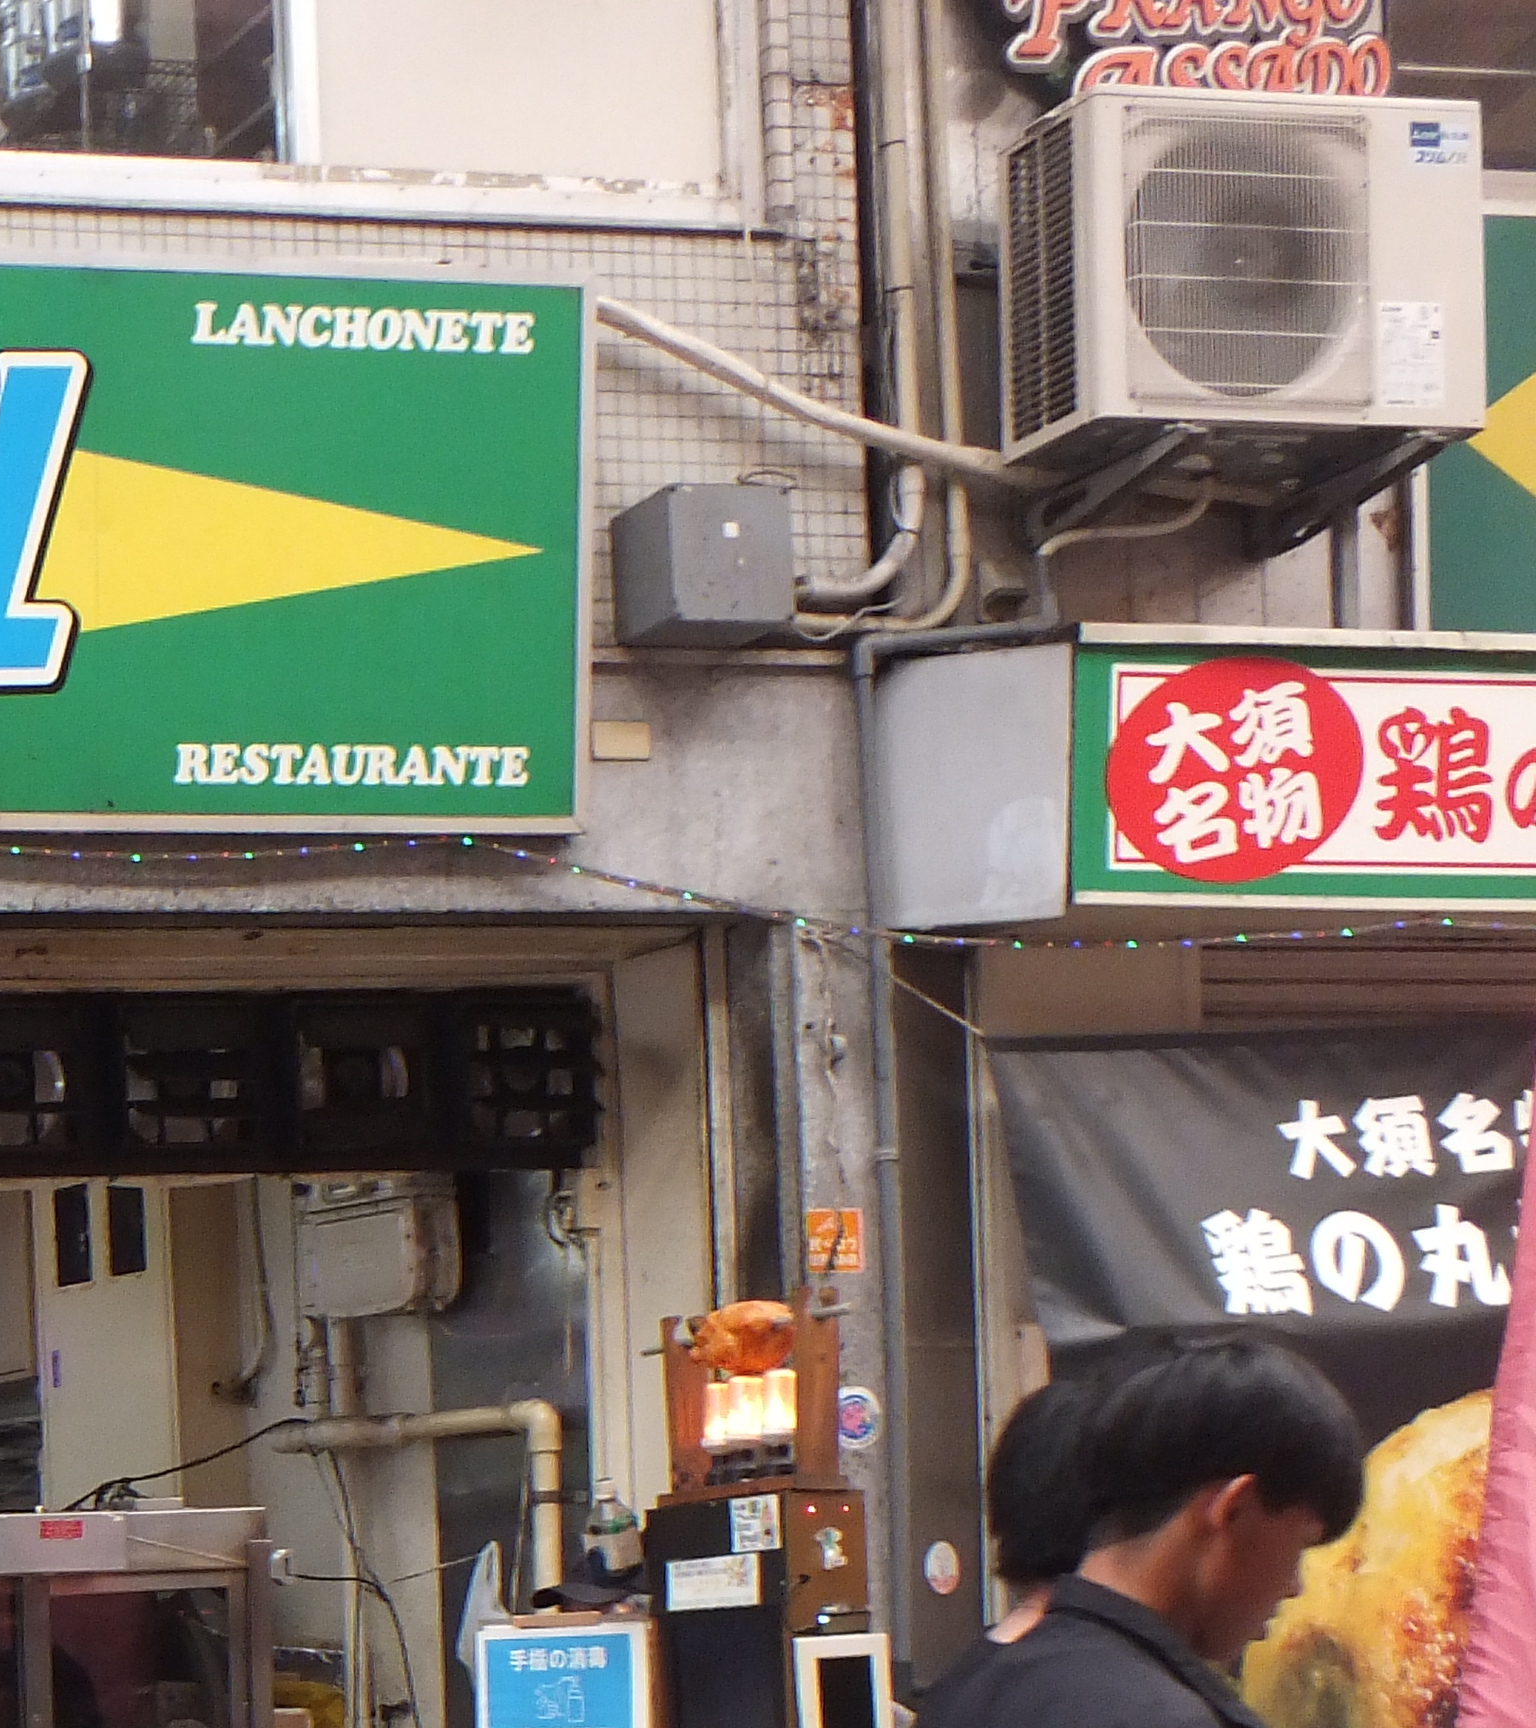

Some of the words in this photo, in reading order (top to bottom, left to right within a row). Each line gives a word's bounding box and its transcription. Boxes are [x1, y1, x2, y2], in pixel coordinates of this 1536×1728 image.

[191, 302, 535, 353] LANCHONETE
[174, 743, 530, 787] RESTAURANTE
[1145, 681, 1314, 784] 大須
[1154, 767, 1324, 864] 名物
[1276, 1088, 1534, 1180] 大須名
[1200, 1199, 1521, 1317] 鶏の丸
